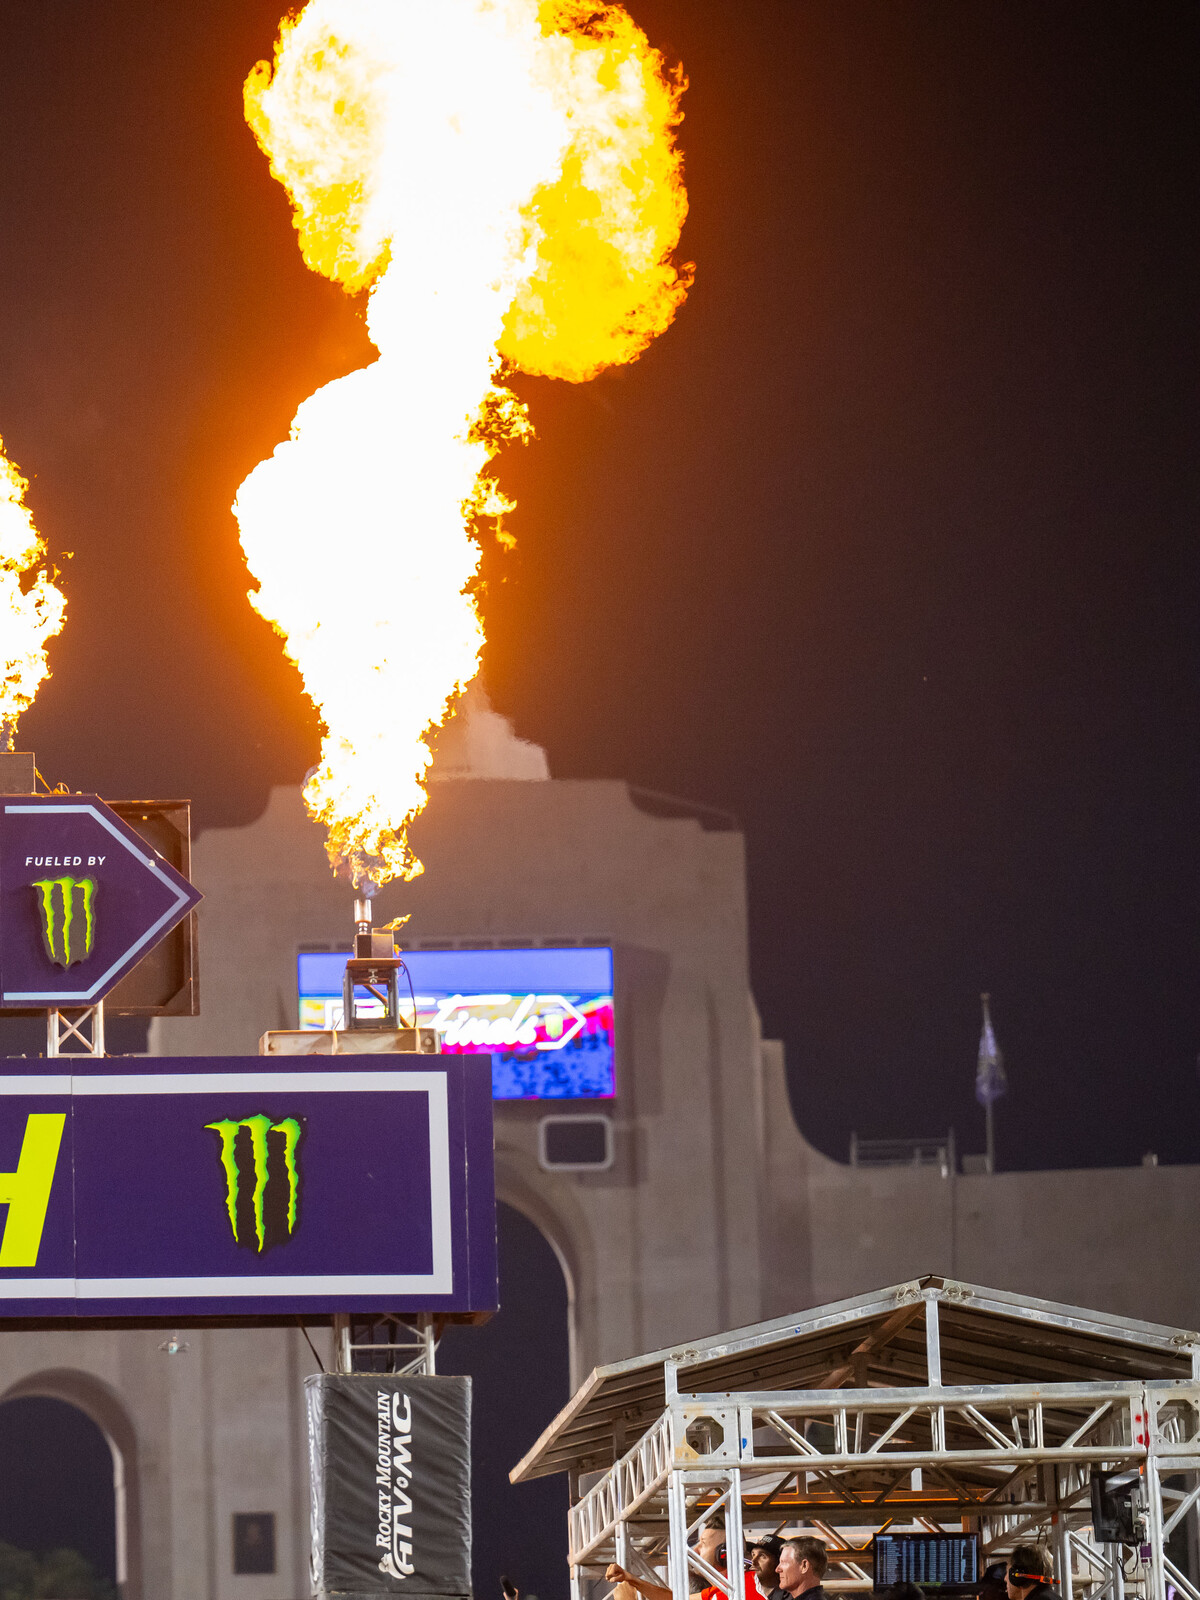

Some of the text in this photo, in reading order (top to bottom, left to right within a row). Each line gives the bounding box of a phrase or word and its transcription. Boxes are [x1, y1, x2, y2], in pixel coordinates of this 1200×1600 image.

[25, 856, 106, 867] FUELED BY
[375, 1390, 392, 1550] ROCKY MOUNTAIN
